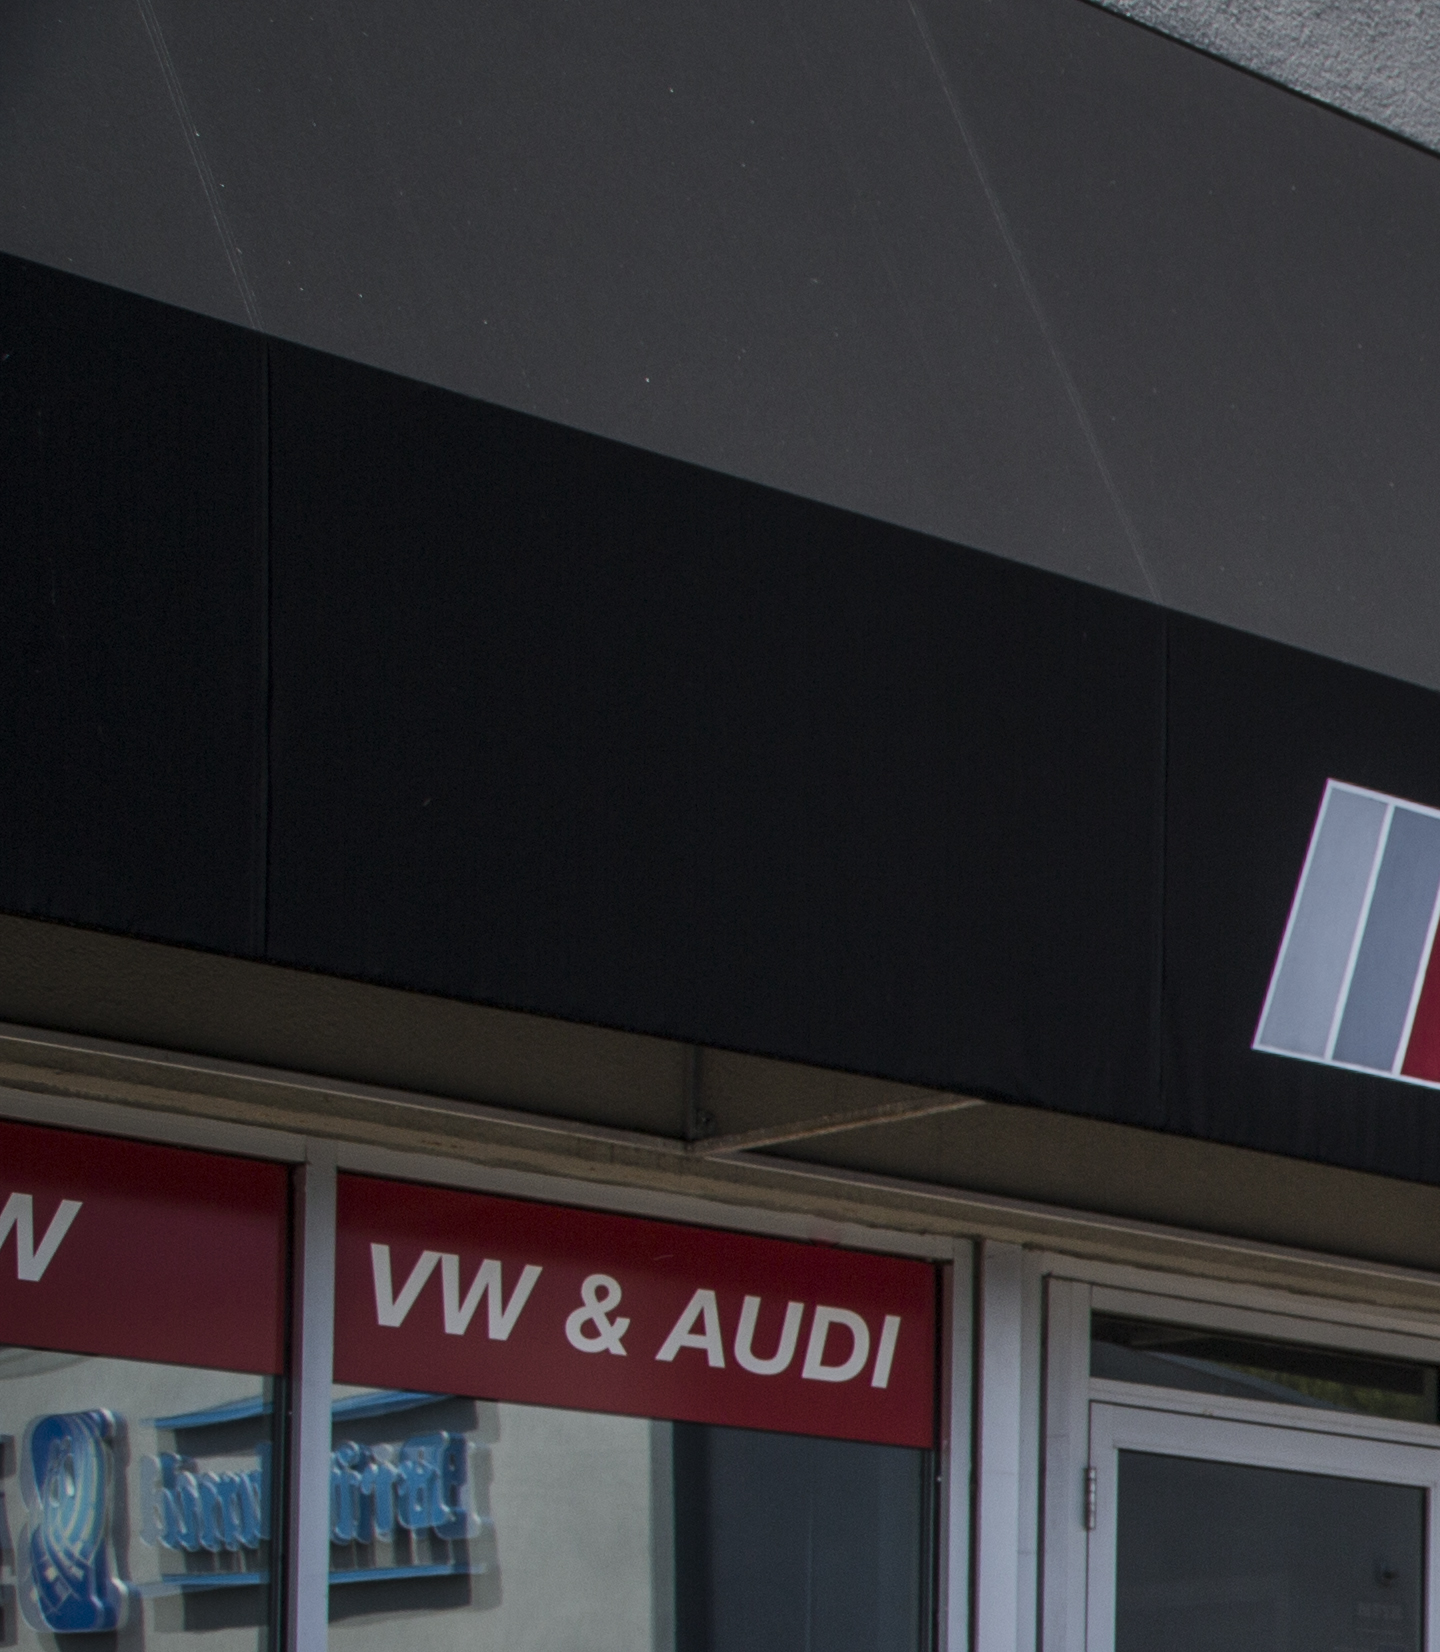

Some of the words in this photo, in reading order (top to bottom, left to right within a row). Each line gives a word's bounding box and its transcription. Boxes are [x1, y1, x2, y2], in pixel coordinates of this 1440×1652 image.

[369, 1243, 542, 1341] VW
[564, 1273, 630, 1356] &
[655, 1288, 902, 1389] AUDI
